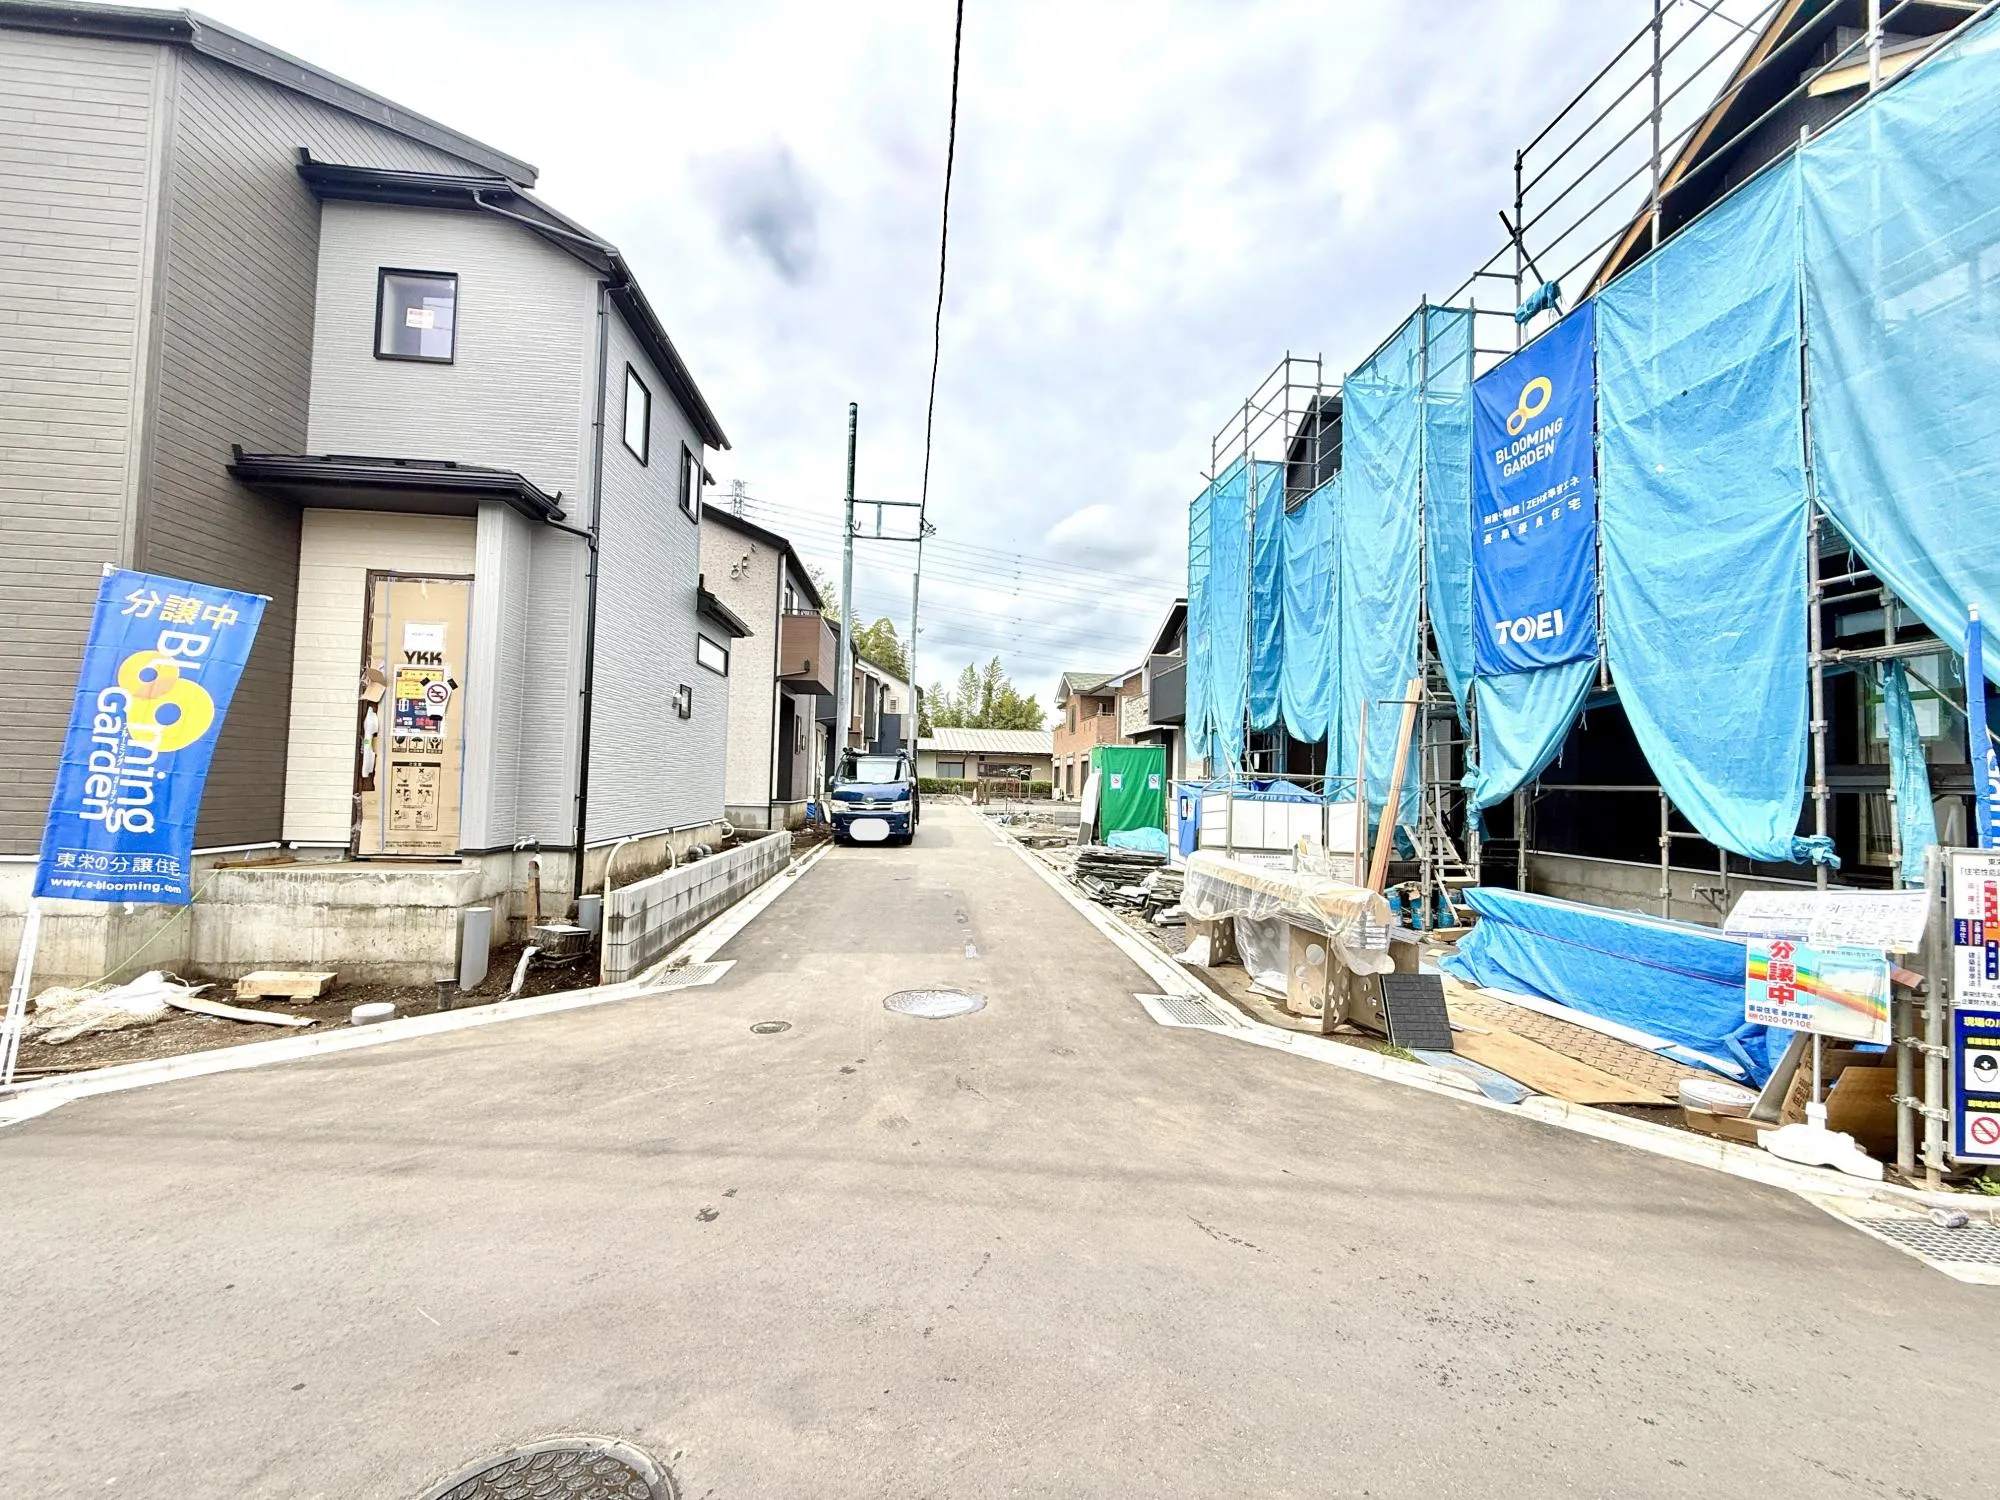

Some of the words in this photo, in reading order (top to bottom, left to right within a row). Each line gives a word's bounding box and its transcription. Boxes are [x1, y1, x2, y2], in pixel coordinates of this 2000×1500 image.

[1495, 417, 1563, 465] BLOOMING
[1503, 442, 1556, 478] GARDEN
[1484, 497, 1582, 545] 長期優良住宅
[121, 588, 240, 631] 分譲中
[1495, 608, 1564, 645] TOEI
[404, 650, 443, 665] YKK
[79, 686, 131, 822] Garden
[55, 852, 180, 877] 東栄の分譲住宅
[51, 878, 182, 894] www.e-blooming.com
[1767, 939, 1796, 1006] 分譲中
[1963, 1016, 2000, 1028] 現場の
